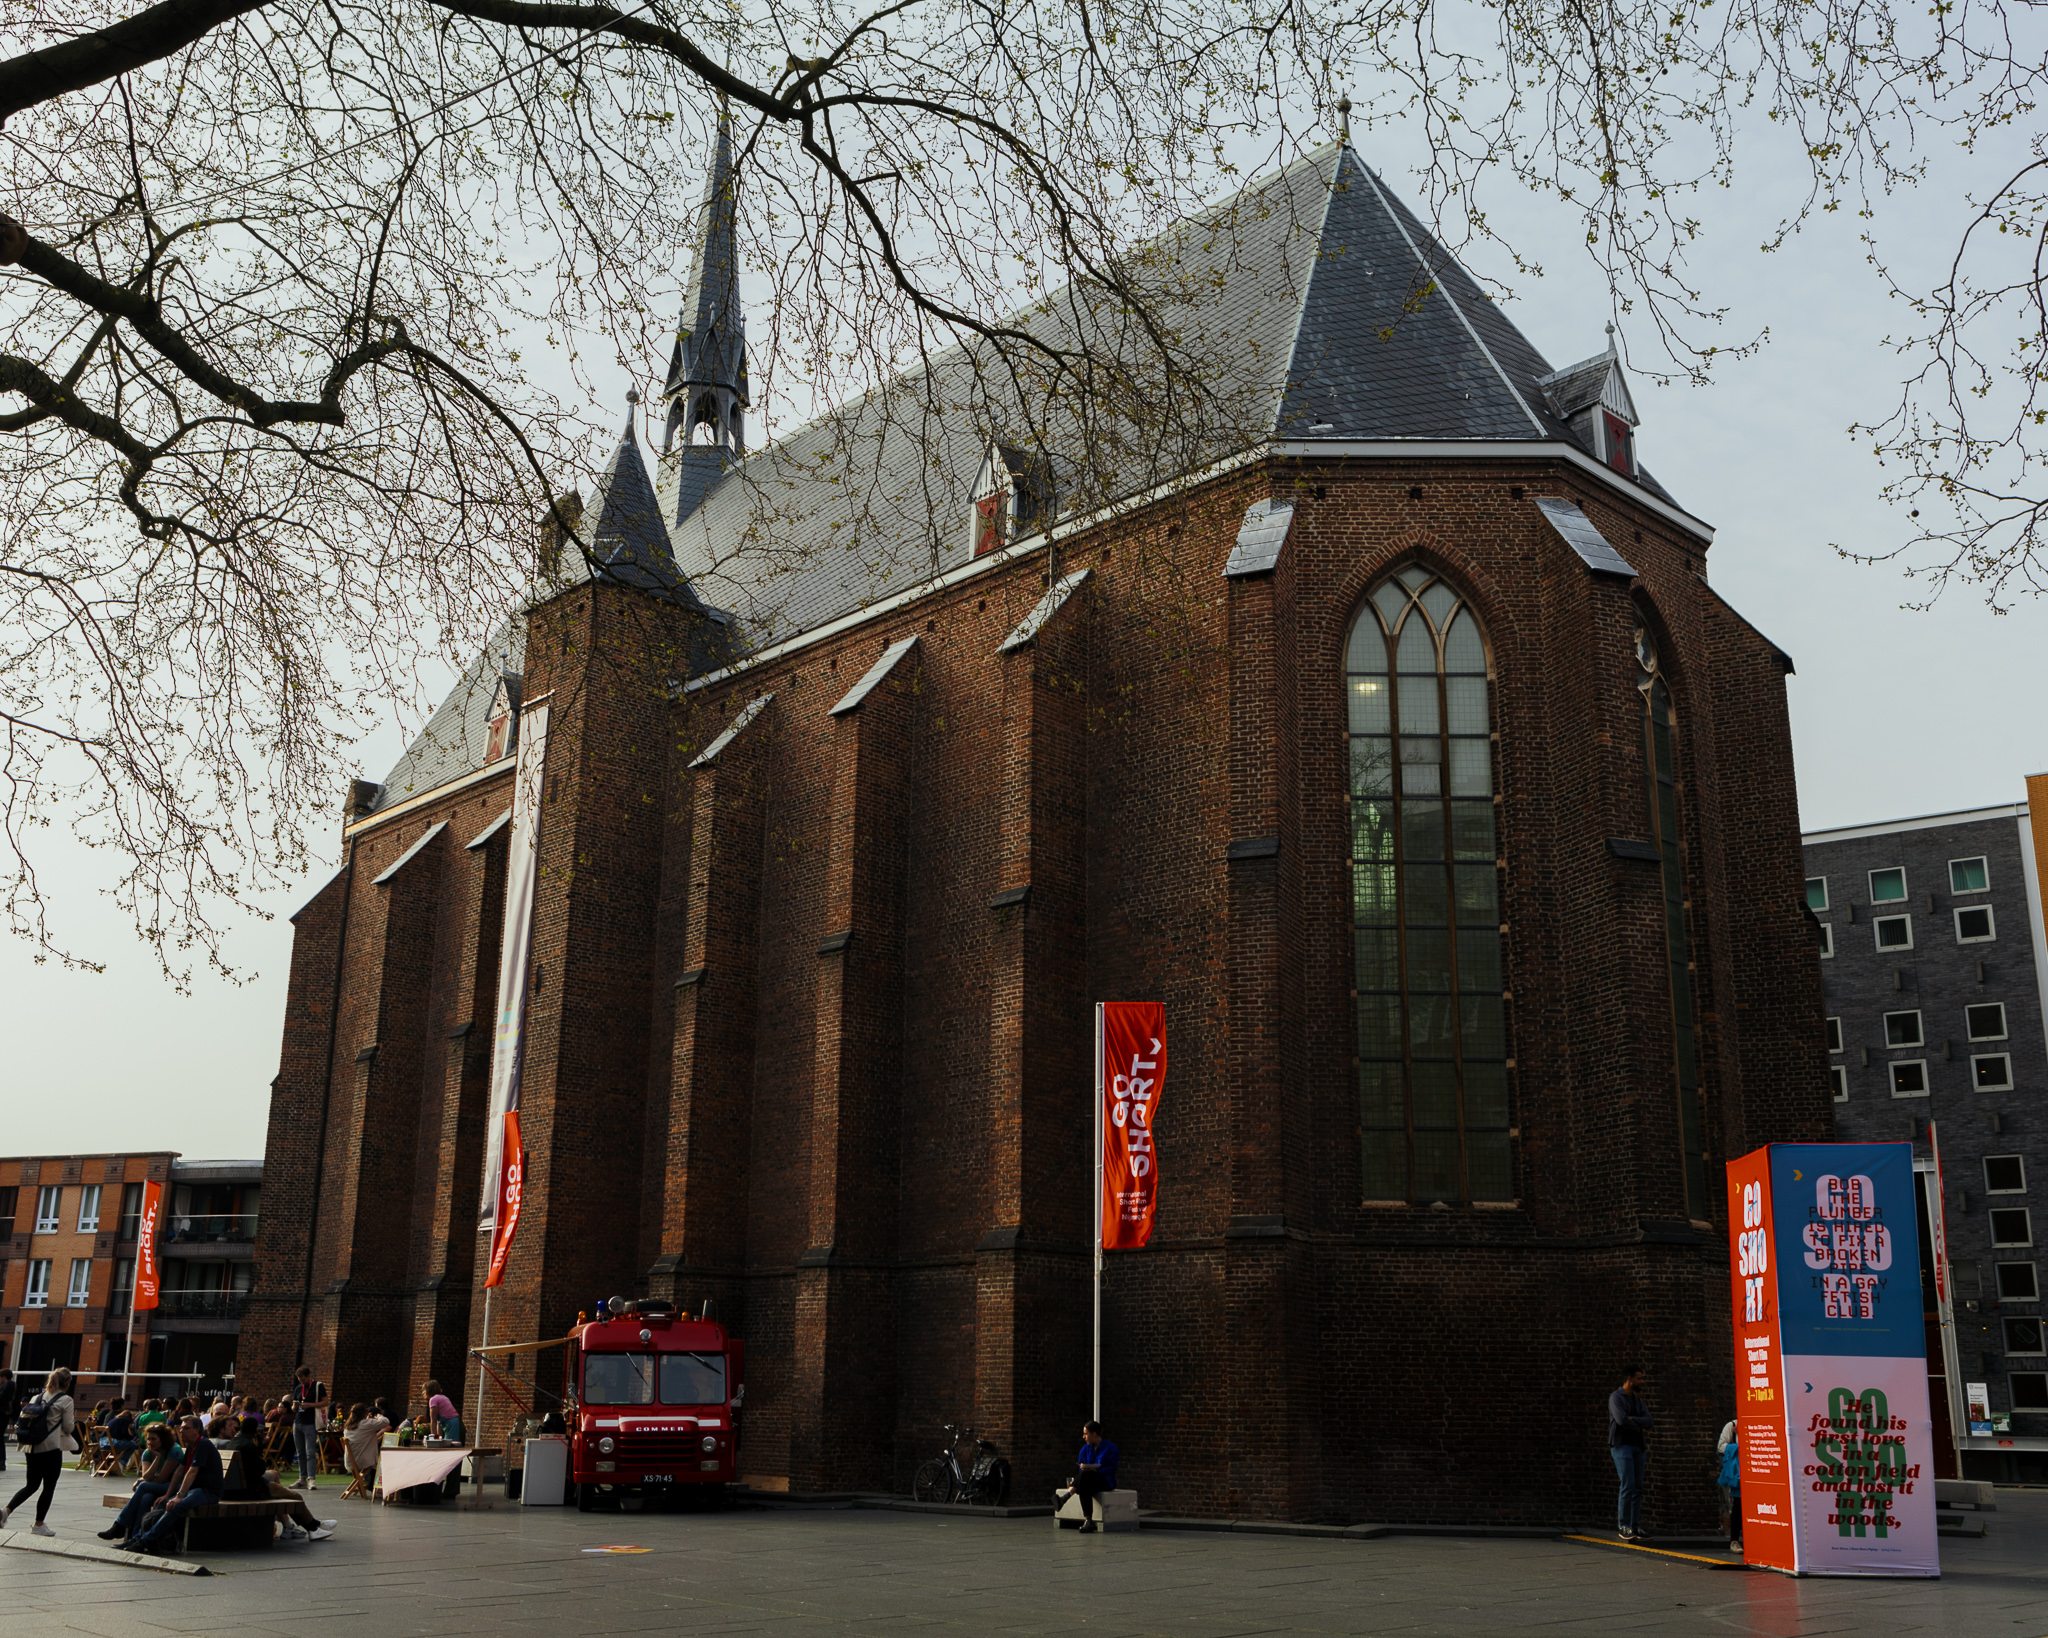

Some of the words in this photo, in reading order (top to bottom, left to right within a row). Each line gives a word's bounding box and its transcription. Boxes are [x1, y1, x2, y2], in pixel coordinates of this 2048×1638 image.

[1111, 1074, 1132, 1129] GO
[1127, 1053, 1157, 1178] SHORT
[506, 1164, 517, 1204] GO
[1828, 1178, 1861, 1191] BOB
[1743, 1180, 1762, 1229] GO
[1816, 1174, 1875, 1222] GO
[1830, 1192, 1860, 1205] THE
[1808, 1206, 1883, 1219] PLUMBER
[1809, 1220, 1826, 1233] IS
[1834, 1220, 1885, 1234] HIRED
[143, 1207, 156, 1275] SHORT
[1810, 1234, 1830, 1246] TO
[1839, 1234, 1867, 1247] FIX
[1875, 1235, 1885, 1248] A
[1738, 1227, 1767, 1277] SHO
[1815, 1248, 1880, 1261] BROKEN
[1830, 1263, 1867, 1275] PIPE
[1811, 1276, 1829, 1289] IN
[1838, 1277, 1848, 1289] A
[1855, 1277, 1888, 1290] GAY
[1745, 1276, 1764, 1323] RT
[1820, 1291, 1881, 1304] FETISH
[1827, 1305, 1875, 1318] CLUB.
[1828, 1387, 1889, 1435] GO
[1846, 1399, 1873, 1414] He
[1807, 1414, 1872, 1431] found
[1876, 1415, 1907, 1431] his
[1810, 1430, 1859, 1448] first
[1863, 1431, 1906, 1446] love
[1842, 1445, 1862, 1461] in
[1867, 1450, 1879, 1461] a
[1804, 1463, 1870, 1477] cotton
[1872, 1463, 1920, 1481] field
[1812, 1478, 1851, 1492] and
[1857, 1478, 1894, 1494] lost
[1899, 1479, 1914, 1495] it
[1835, 1493, 1855, 1509] in
[1860, 1495, 1893, 1511] the
[1828, 1512, 1902, 1529] woods,
